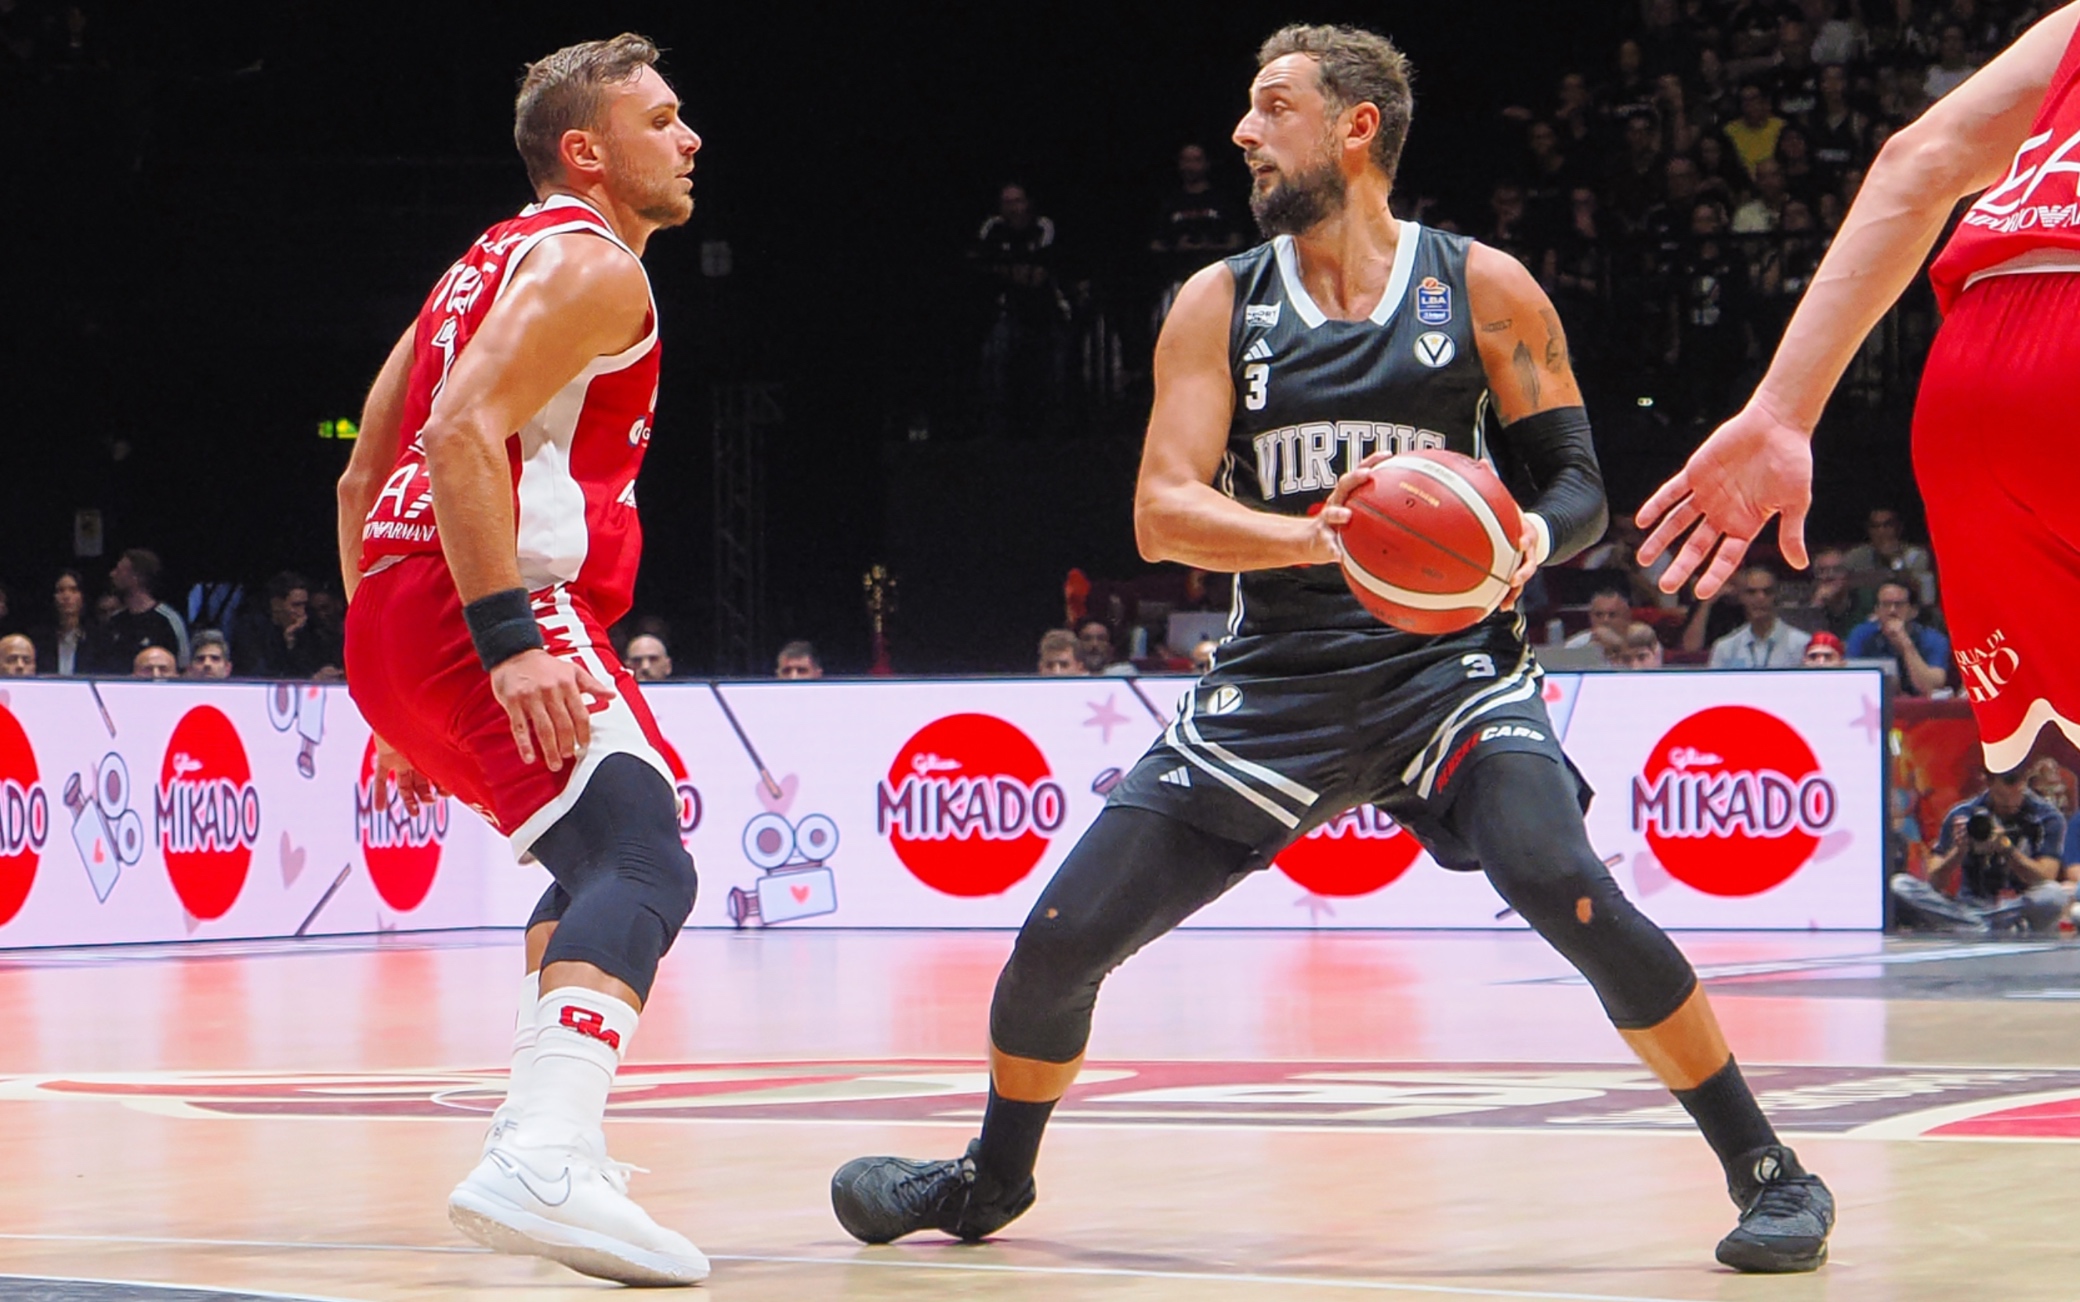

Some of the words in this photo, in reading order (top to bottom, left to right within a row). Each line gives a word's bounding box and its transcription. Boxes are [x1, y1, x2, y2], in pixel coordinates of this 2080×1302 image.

[1244, 363, 1269, 410] 3
[1462, 653, 1496, 678] 3
[1480, 726, 1546, 741] CARD
[155, 781, 260, 848] MIKADO
[877, 779, 1067, 835] MIKADO
[1632, 775, 1836, 832] MIKADO
